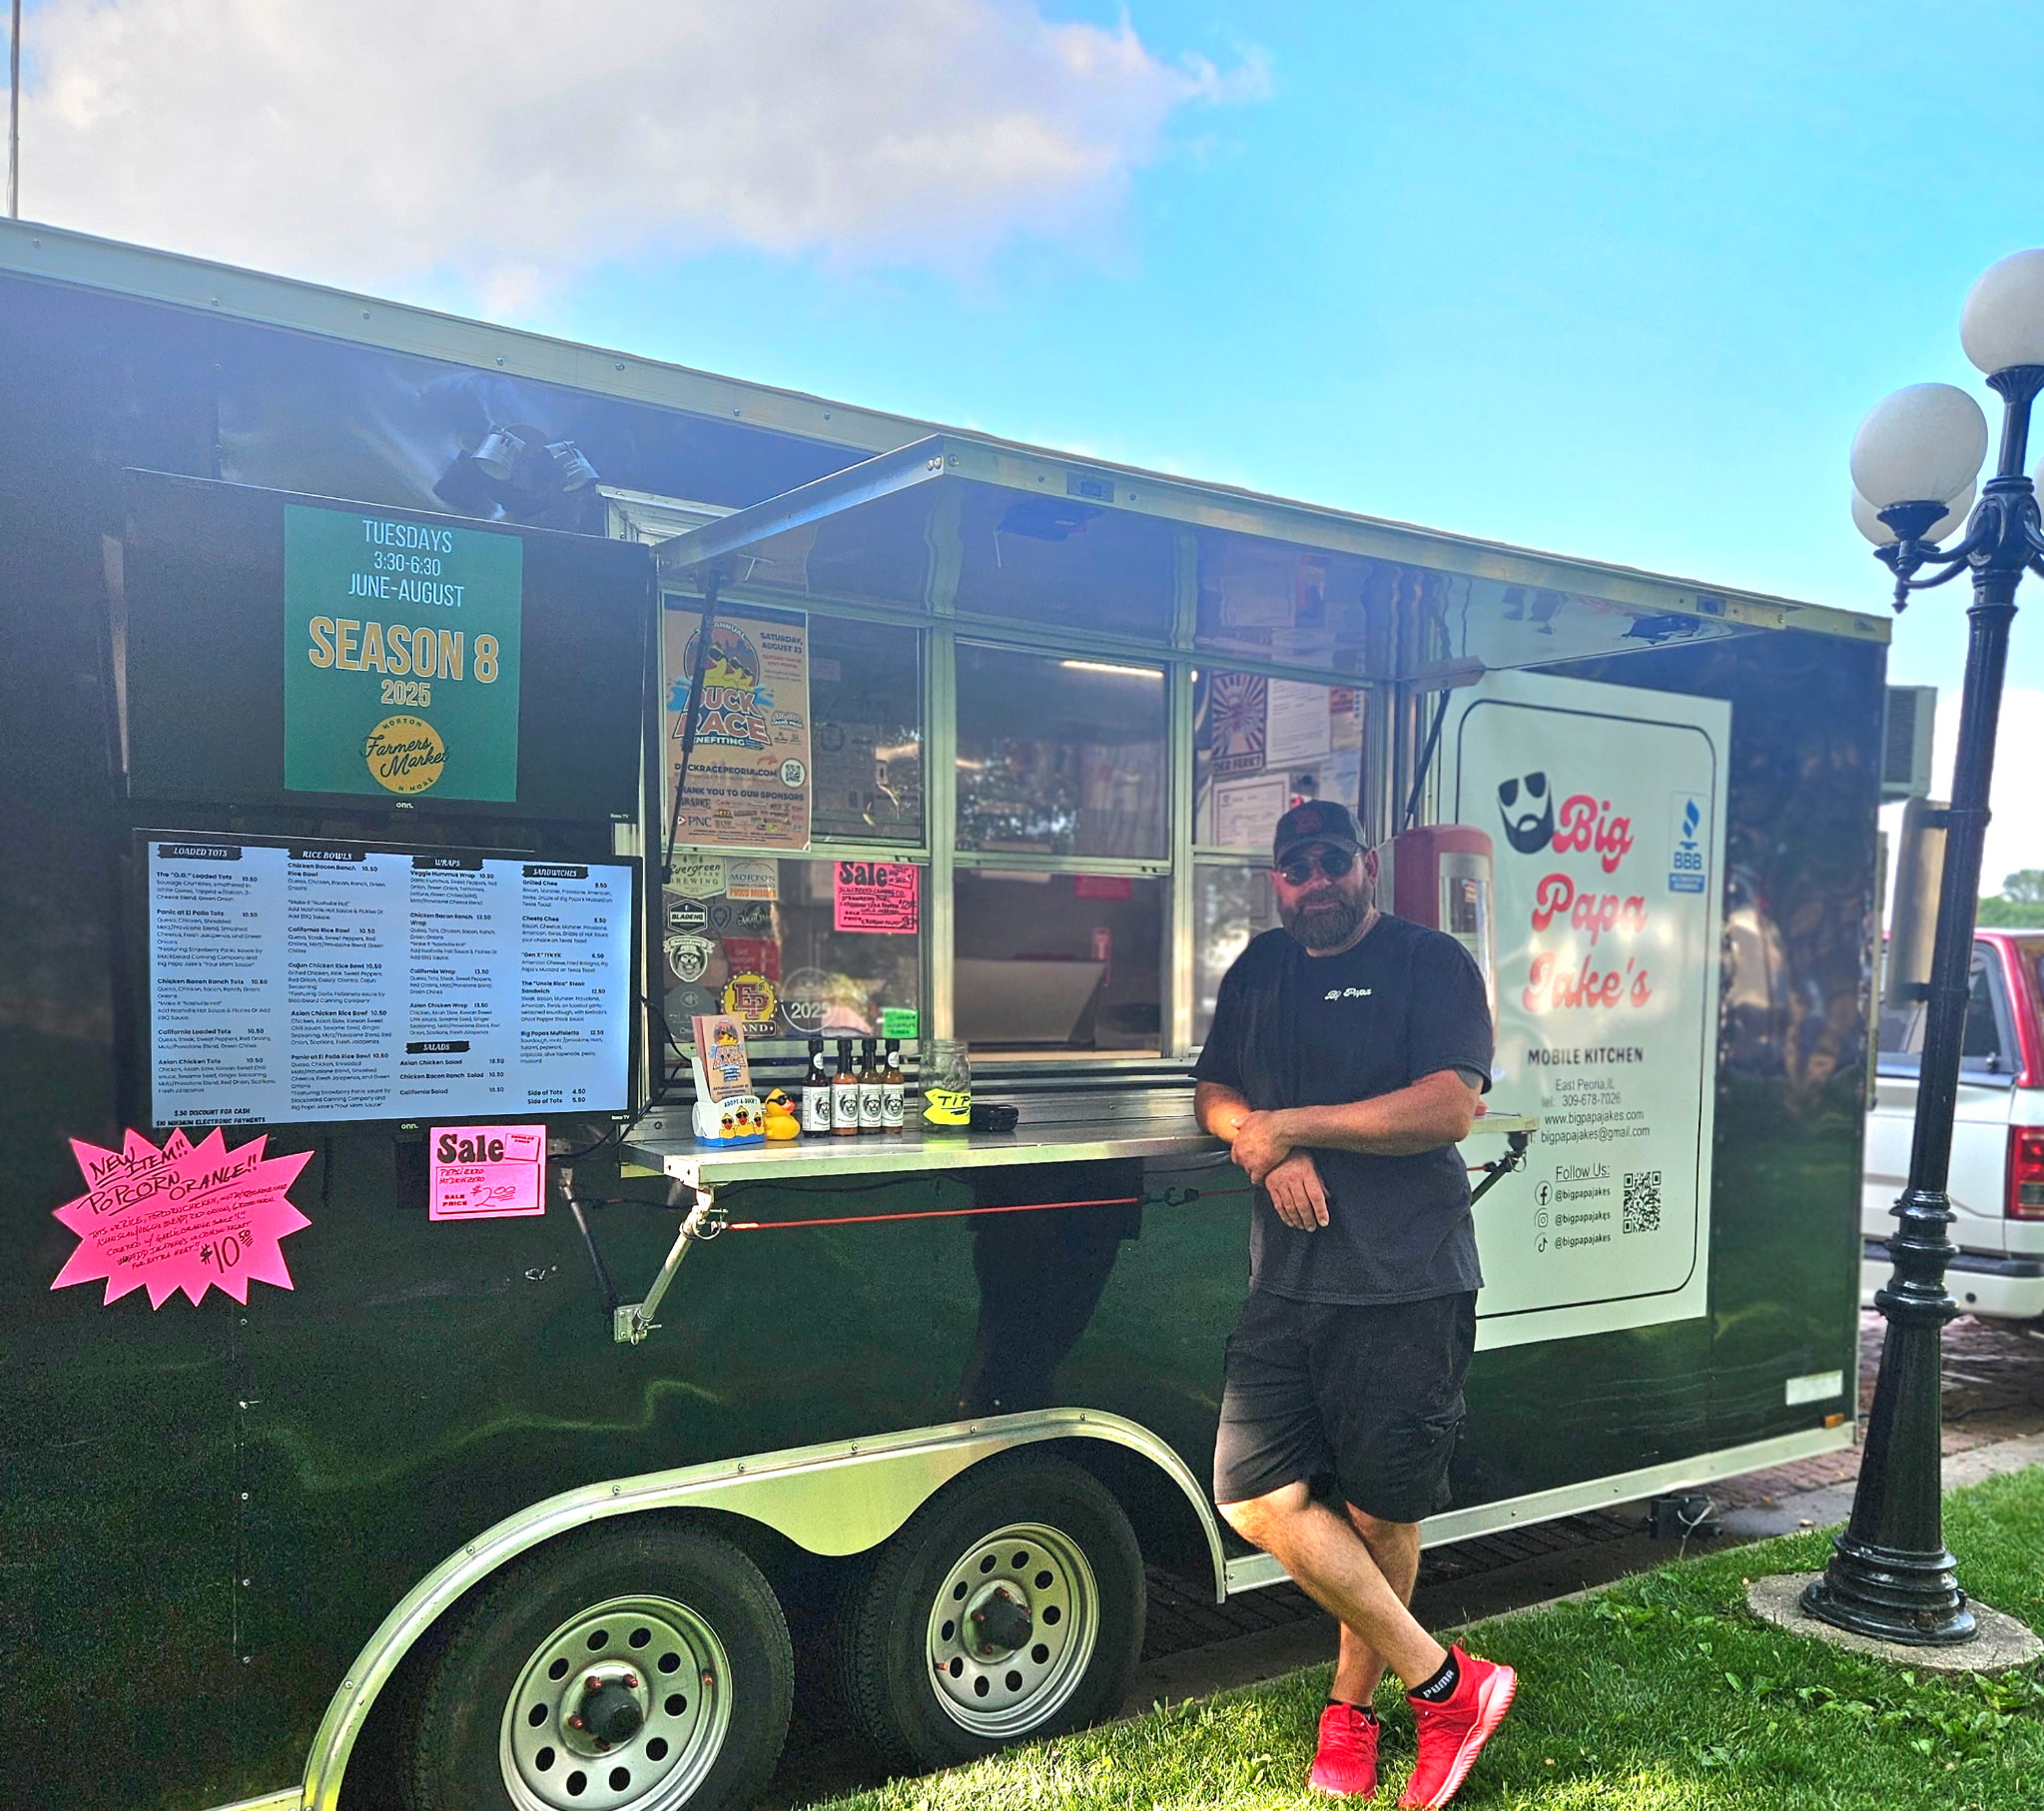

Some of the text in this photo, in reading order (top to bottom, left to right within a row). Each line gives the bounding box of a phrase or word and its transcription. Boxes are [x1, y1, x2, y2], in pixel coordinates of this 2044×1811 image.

[362, 520, 452, 553] TUESDAYS
[374, 551, 440, 576] 3:30-6:30
[347, 573, 464, 607] JUNE-AUGUST
[760, 632, 803, 645] SATURDAY,
[762, 643, 792, 652] AUGUST
[309, 616, 499, 683] SEASON 8
[381, 680, 431, 707] 2025
[382, 719, 421, 729] MORTON
[359, 735, 431, 758] Farmers
[690, 736, 745, 746] ENEFITING
[380, 746, 450, 778] Market
[674, 763, 778, 777] DCKRACEPEORIA.COM
[409, 777, 433, 791] MORE
[760, 791, 804, 801] SPONSORS
[688, 816, 712, 827] PNC
[1552, 794, 1635, 874] Big
[1674, 852, 1702, 870] BBB
[533, 868, 577, 878] SANDWICHES
[670, 864, 721, 877] Evergreen
[839, 862, 888, 887] Sale
[1532, 873, 1648, 946] Papa
[1523, 951, 1652, 1012] Jake's
[791, 1002, 831, 1018] 2025
[1528, 1047, 1644, 1065] MOBILE KITCHEN
[1556, 1079, 1575, 1091] East
[1562, 1091, 1622, 1107] 309-678-7026
[1545, 1110, 1645, 1126] www.bigpapajakes.com
[1541, 1126, 1650, 1145] bigpapajakes@gmail.com
[437, 1133, 504, 1164] Sale
[89, 1146, 135, 1181] NEW
[125, 1138, 188, 1178] ITEM!!
[1556, 1162, 1610, 1180] Follow Us:
[77, 1171, 181, 1214] POPCORN
[169, 1154, 257, 1201] ORANGE!!
[1555, 1187, 1611, 1202] @bigpapajakes
[1555, 1210, 1611, 1226] @bigpapajakes
[1555, 1233, 1611, 1249] @bigpapajakes
[1423, 1669, 1455, 1699] PUMA
